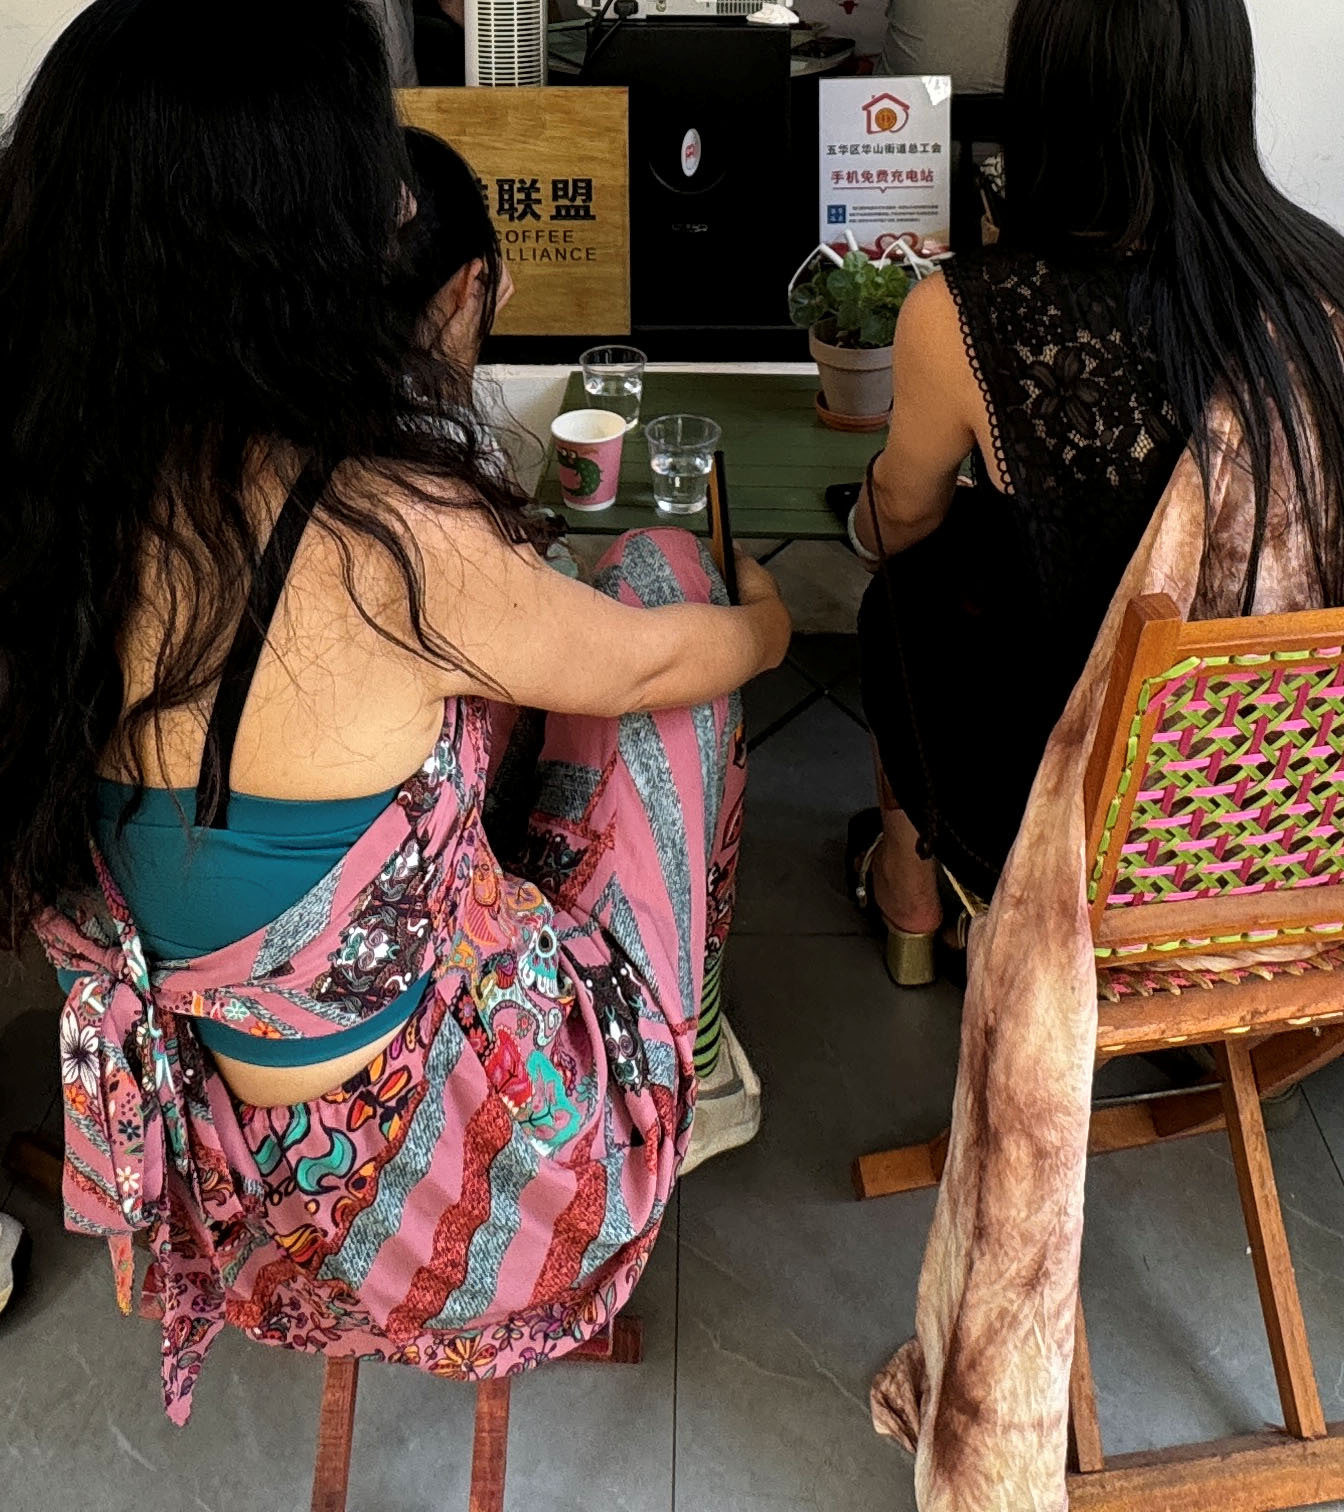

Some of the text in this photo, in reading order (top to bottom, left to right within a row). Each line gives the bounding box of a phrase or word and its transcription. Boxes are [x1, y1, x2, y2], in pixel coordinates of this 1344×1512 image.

[826, 142, 942, 156] 五华区华山街道总工会
[831, 169, 935, 185] 手机免费充电站
[506, 247, 597, 261] LLIANCE
